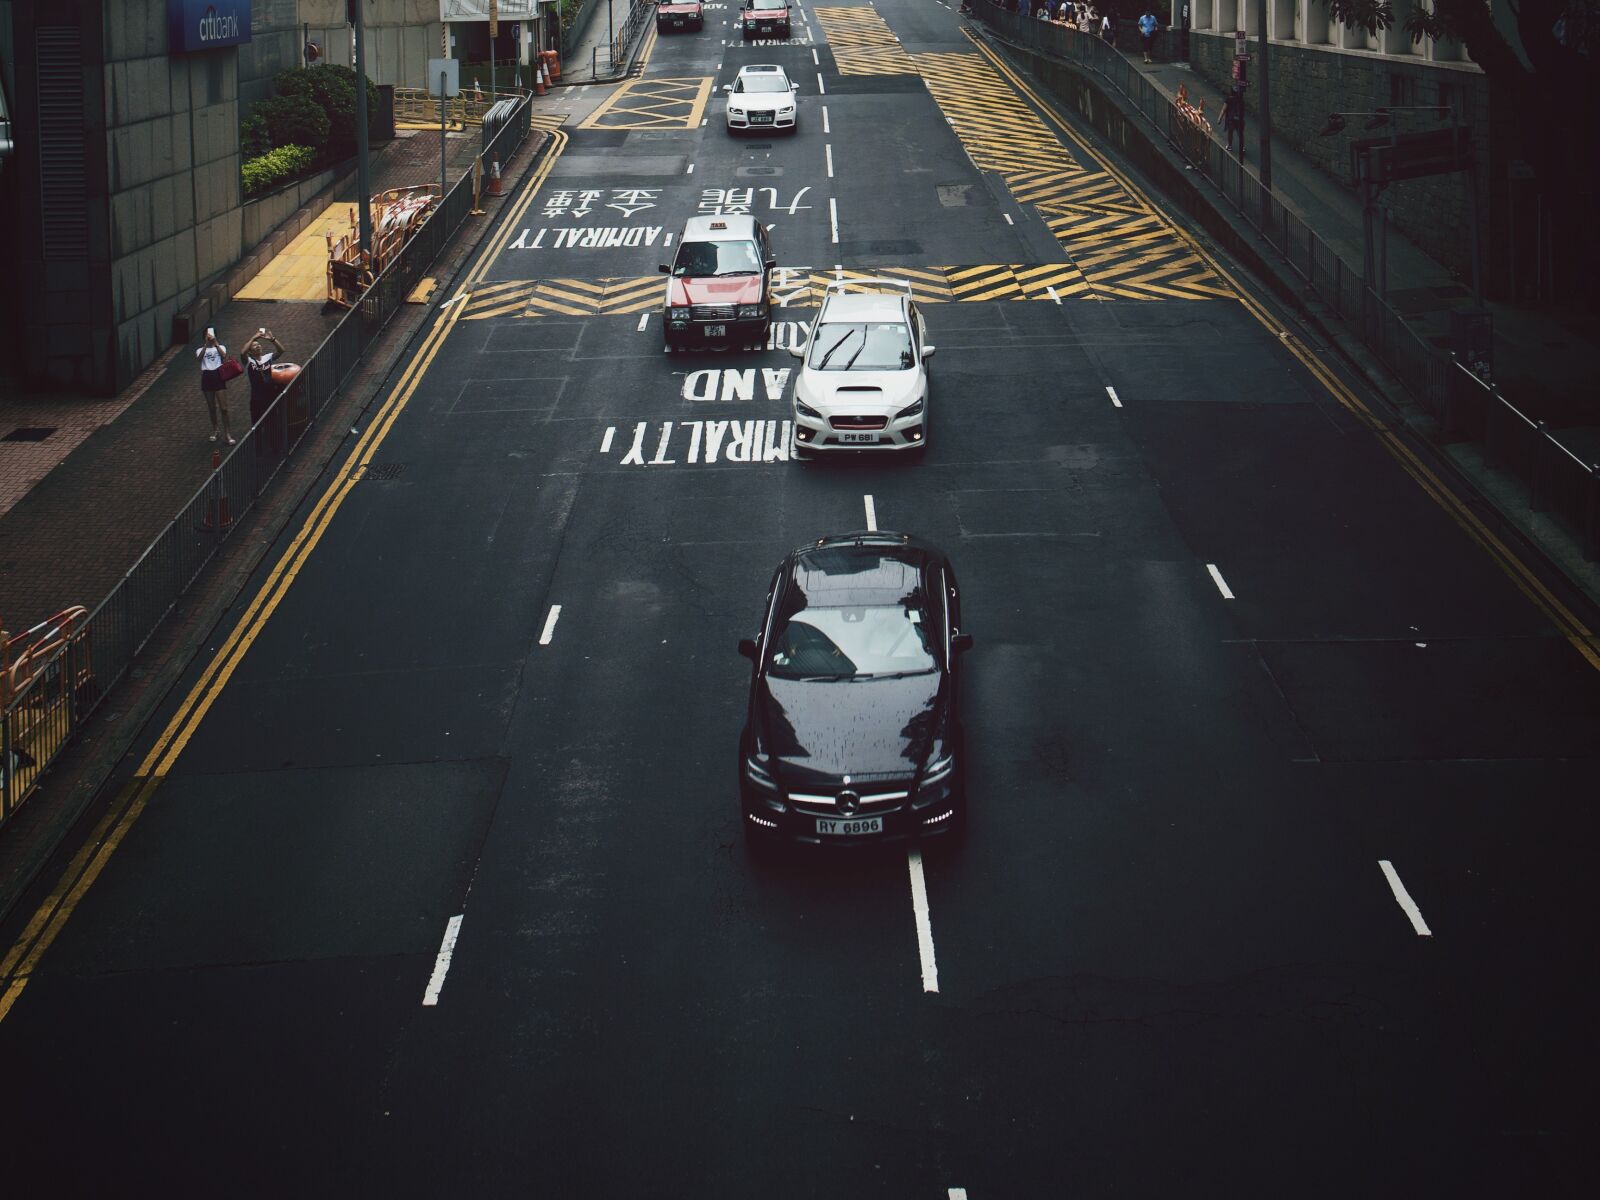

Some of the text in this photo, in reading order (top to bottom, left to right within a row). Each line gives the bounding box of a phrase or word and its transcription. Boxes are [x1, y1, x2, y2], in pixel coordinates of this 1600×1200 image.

[200, 7, 239, 41] citibank
[541, 189, 664, 218] 金鐘
[508, 226, 663, 249] ADMIRALTY
[681, 368, 792, 401] AND
[619, 420, 800, 465] MIRALTY
[819, 820, 879, 833] RY 6896
